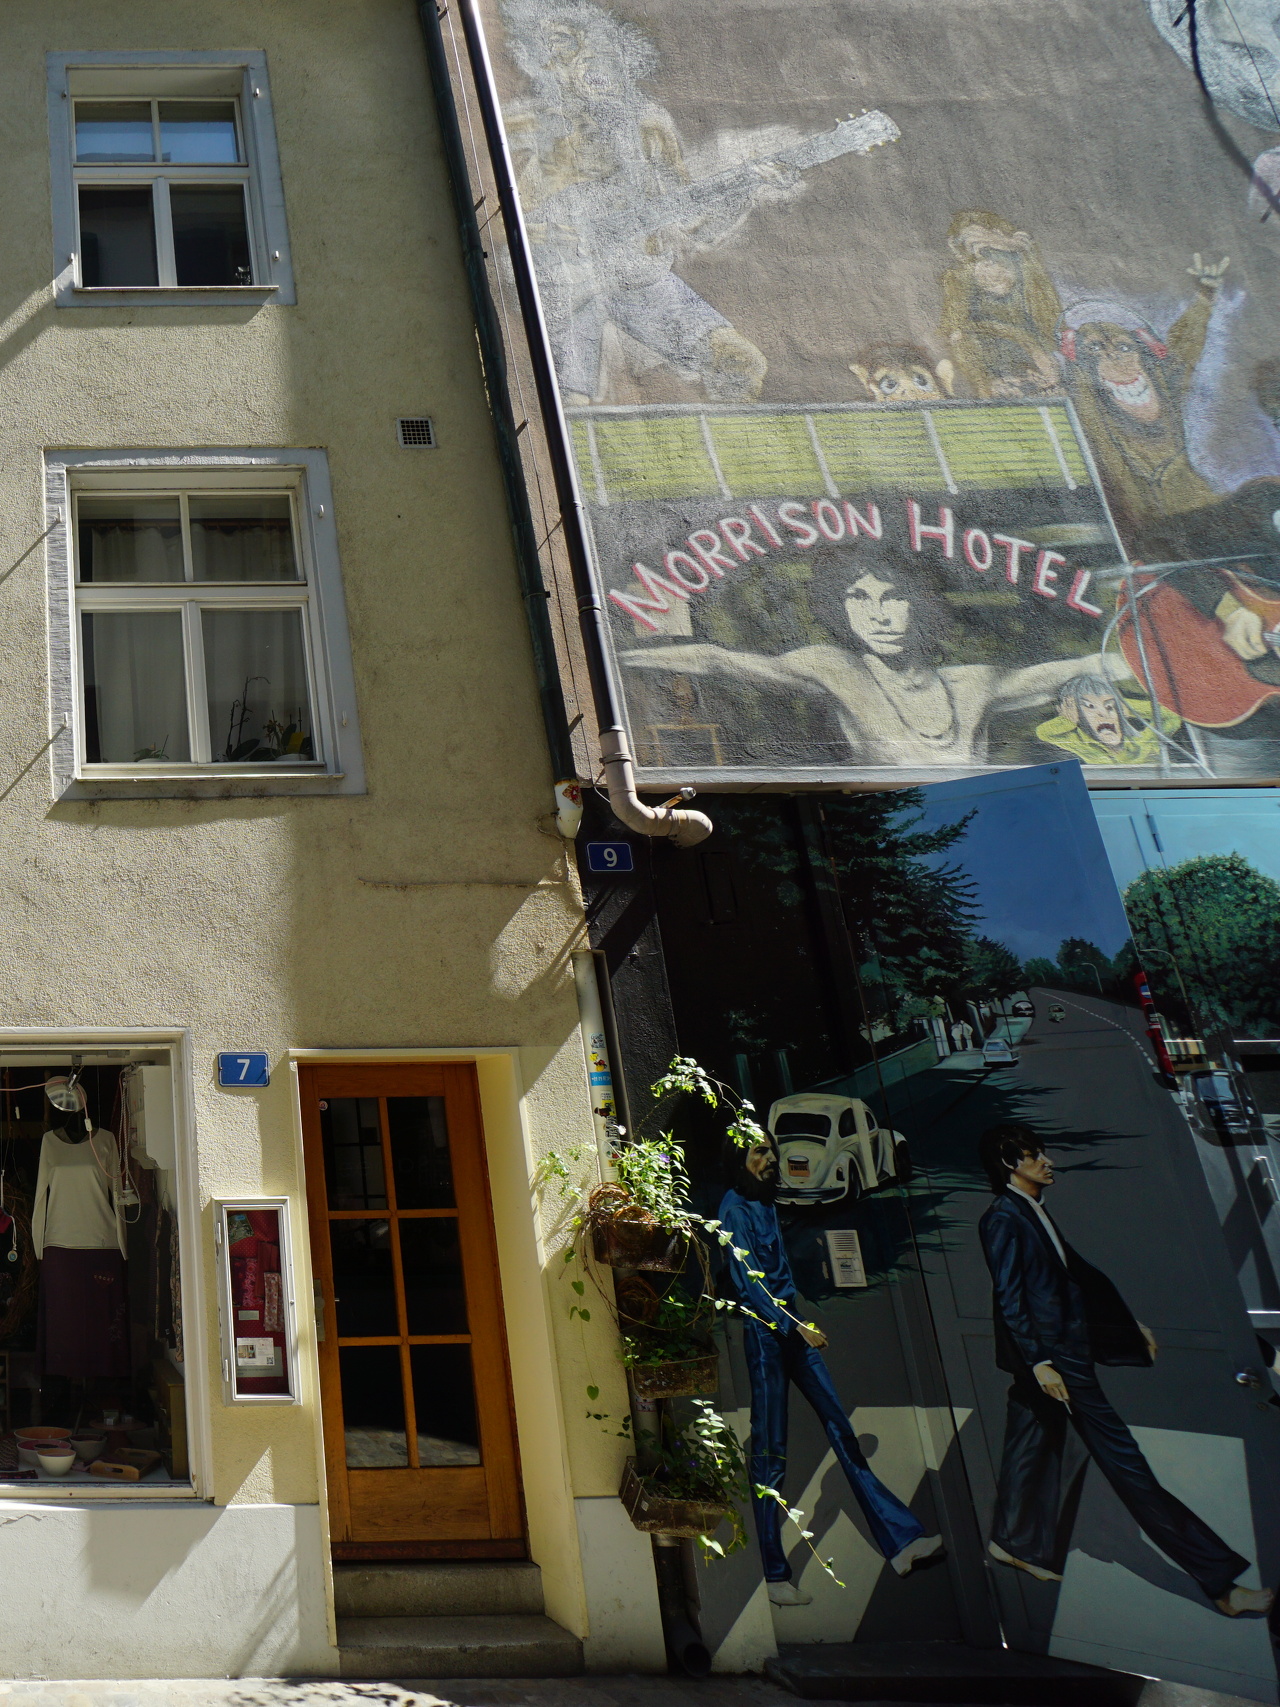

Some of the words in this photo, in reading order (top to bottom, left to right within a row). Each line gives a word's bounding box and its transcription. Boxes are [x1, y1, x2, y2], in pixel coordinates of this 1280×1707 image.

[607, 499, 883, 631] MORRISON
[906, 498, 1104, 618] HOTEL
[603, 847, 618, 868] 9
[236, 1058, 251, 1081] 7
